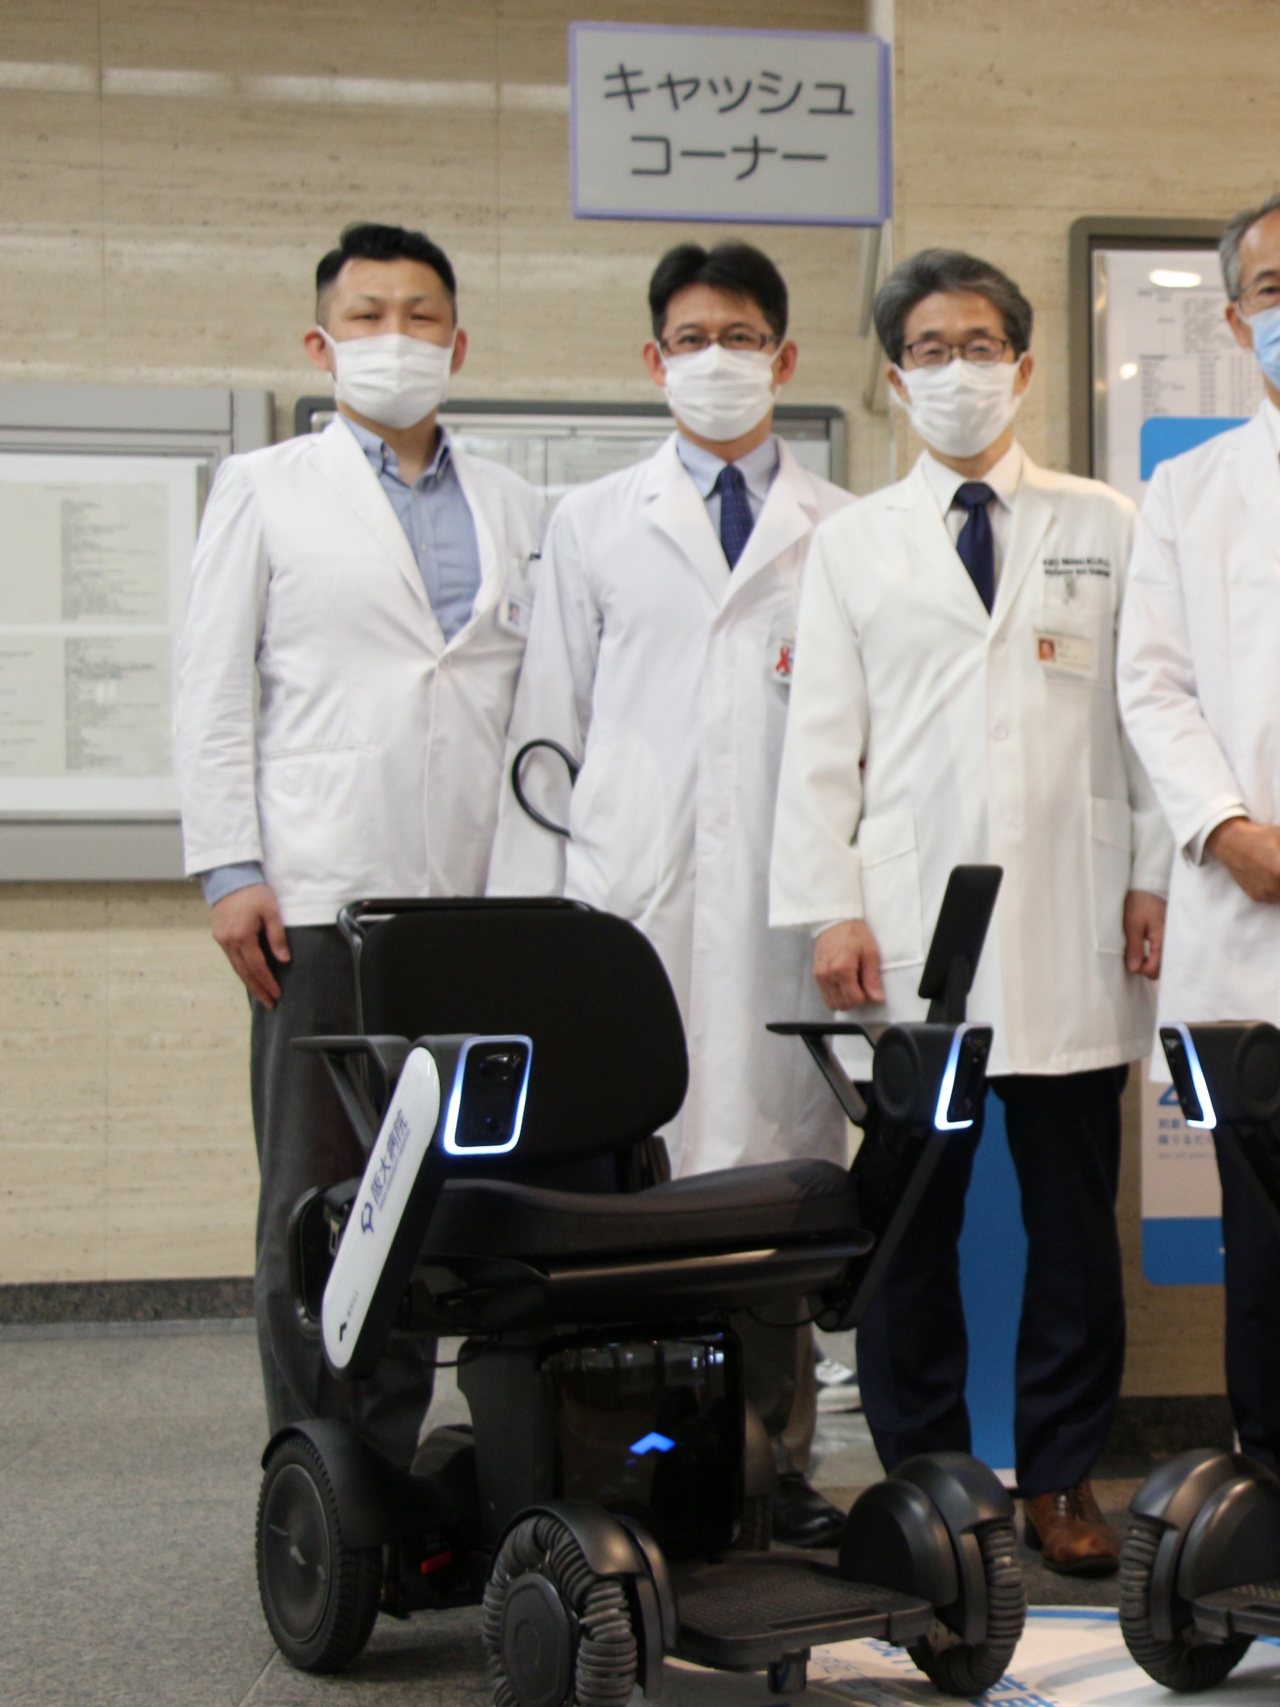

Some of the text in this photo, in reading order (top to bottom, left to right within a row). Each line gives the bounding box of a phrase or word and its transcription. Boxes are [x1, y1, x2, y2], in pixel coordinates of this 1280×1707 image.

[604, 63, 854, 115] キャッシュ
[631, 135, 828, 181] コーナー
